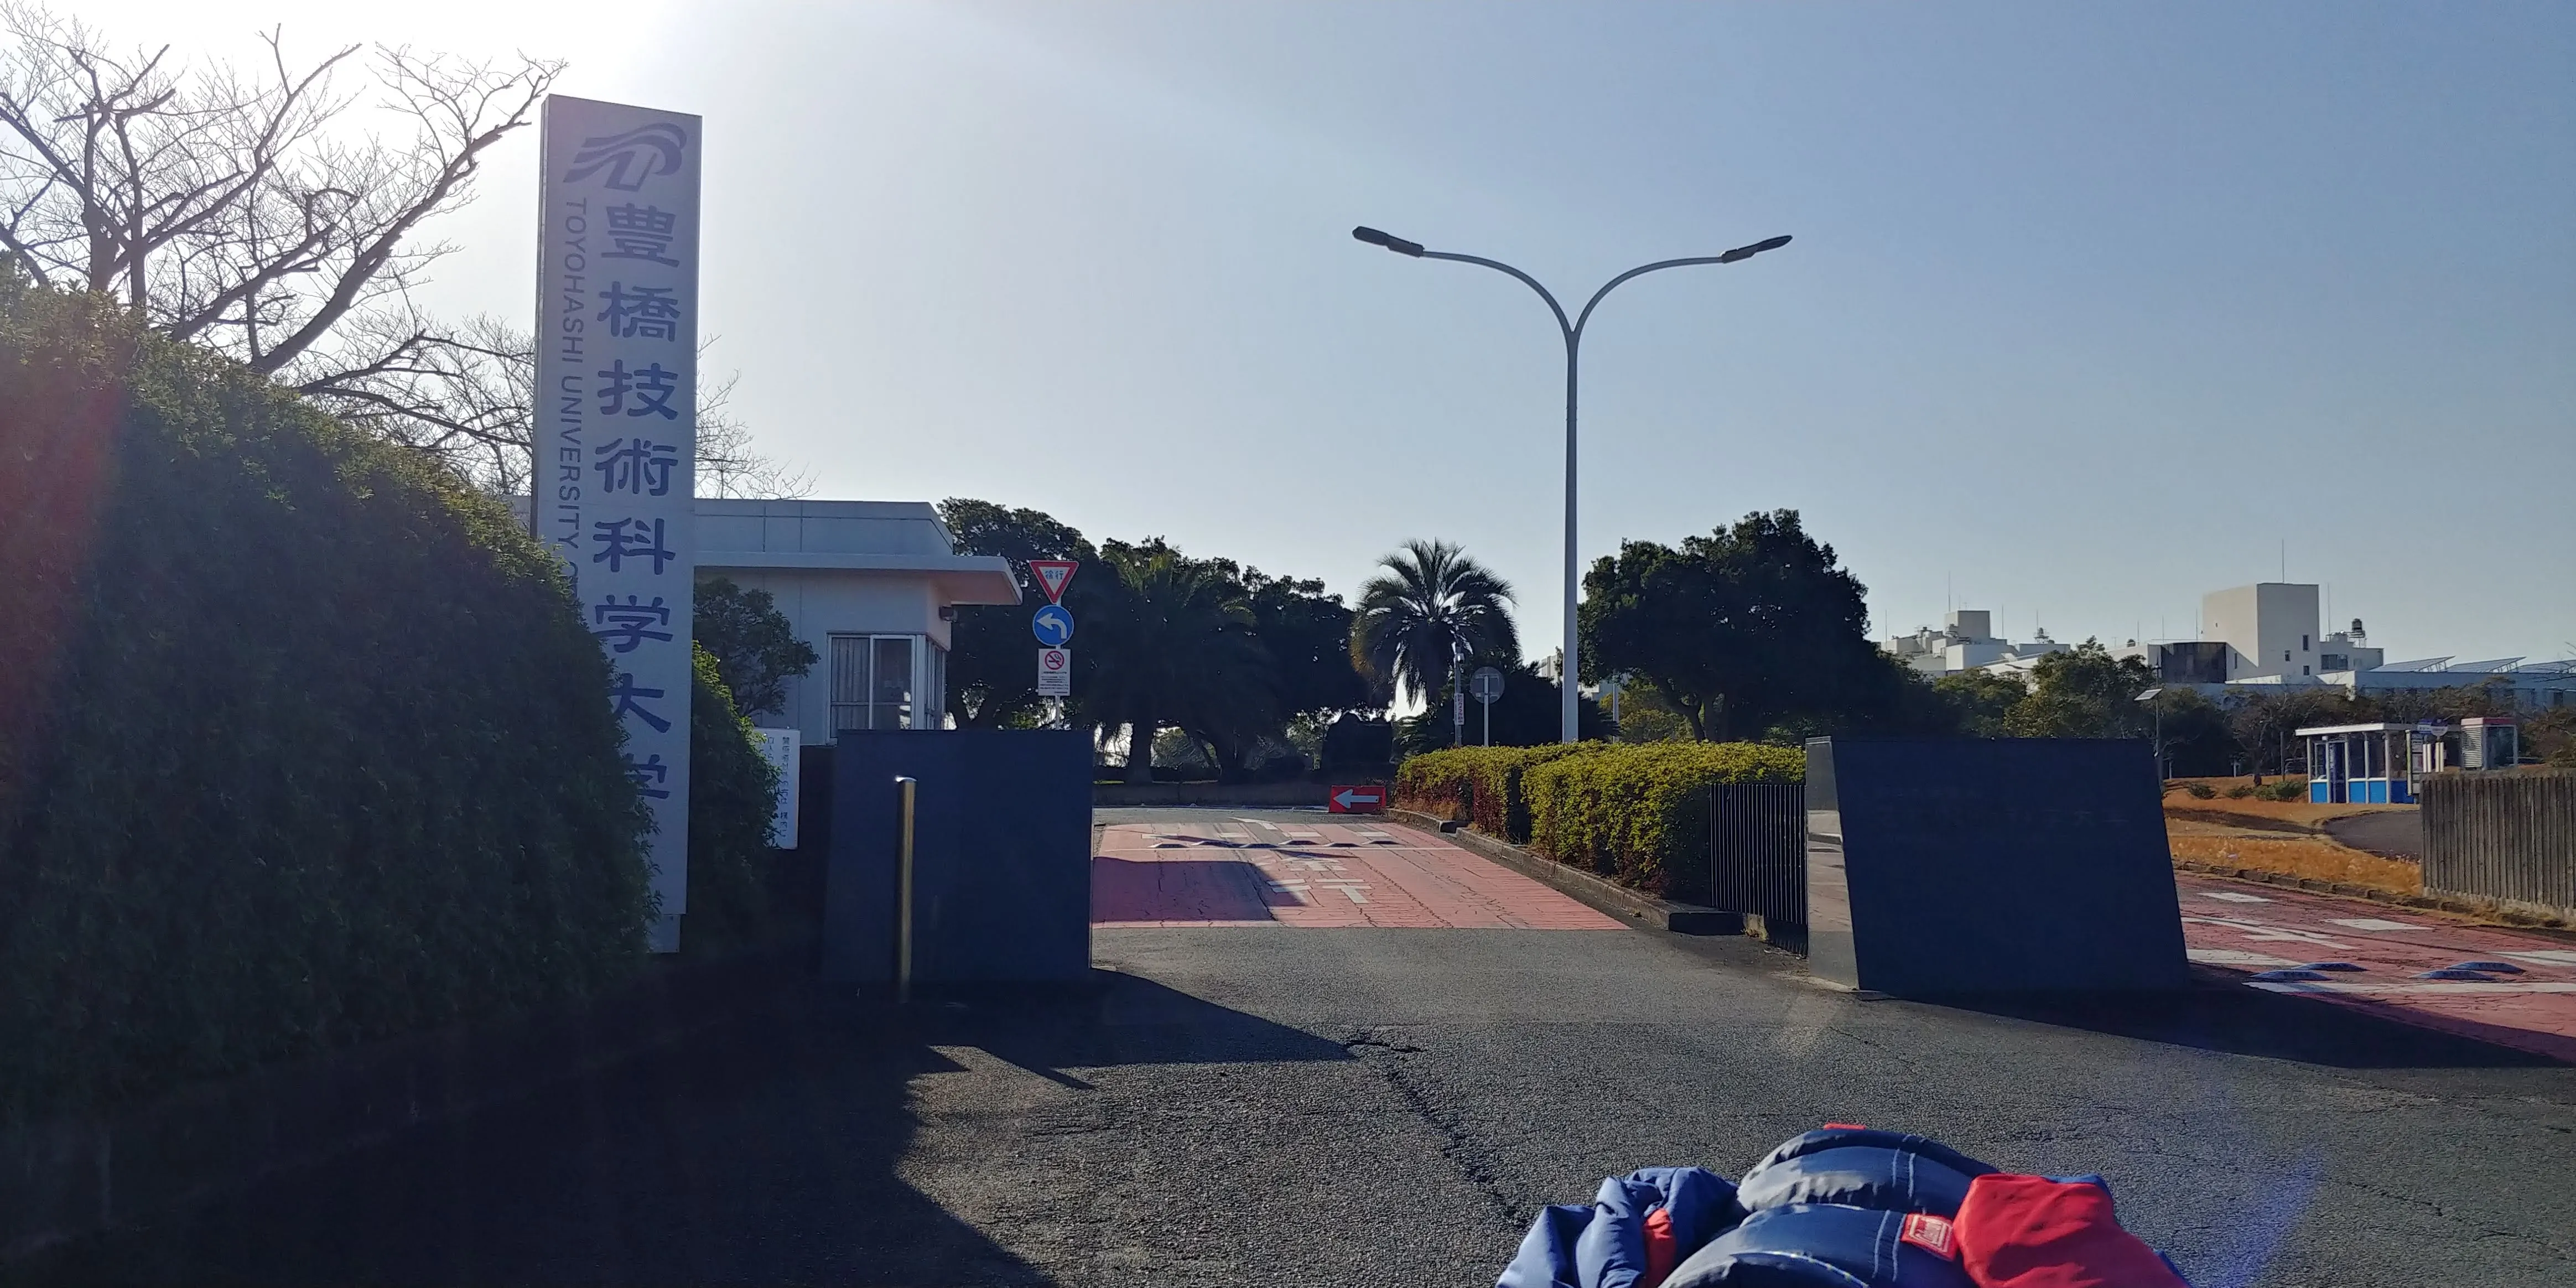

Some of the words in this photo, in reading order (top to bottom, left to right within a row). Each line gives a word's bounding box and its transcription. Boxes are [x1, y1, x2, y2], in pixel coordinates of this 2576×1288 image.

[562, 197, 586, 363] TOYOHASHI
[557, 376, 583, 549] UNIVERSITY
[1045, 570, 1064, 580] 徐行
